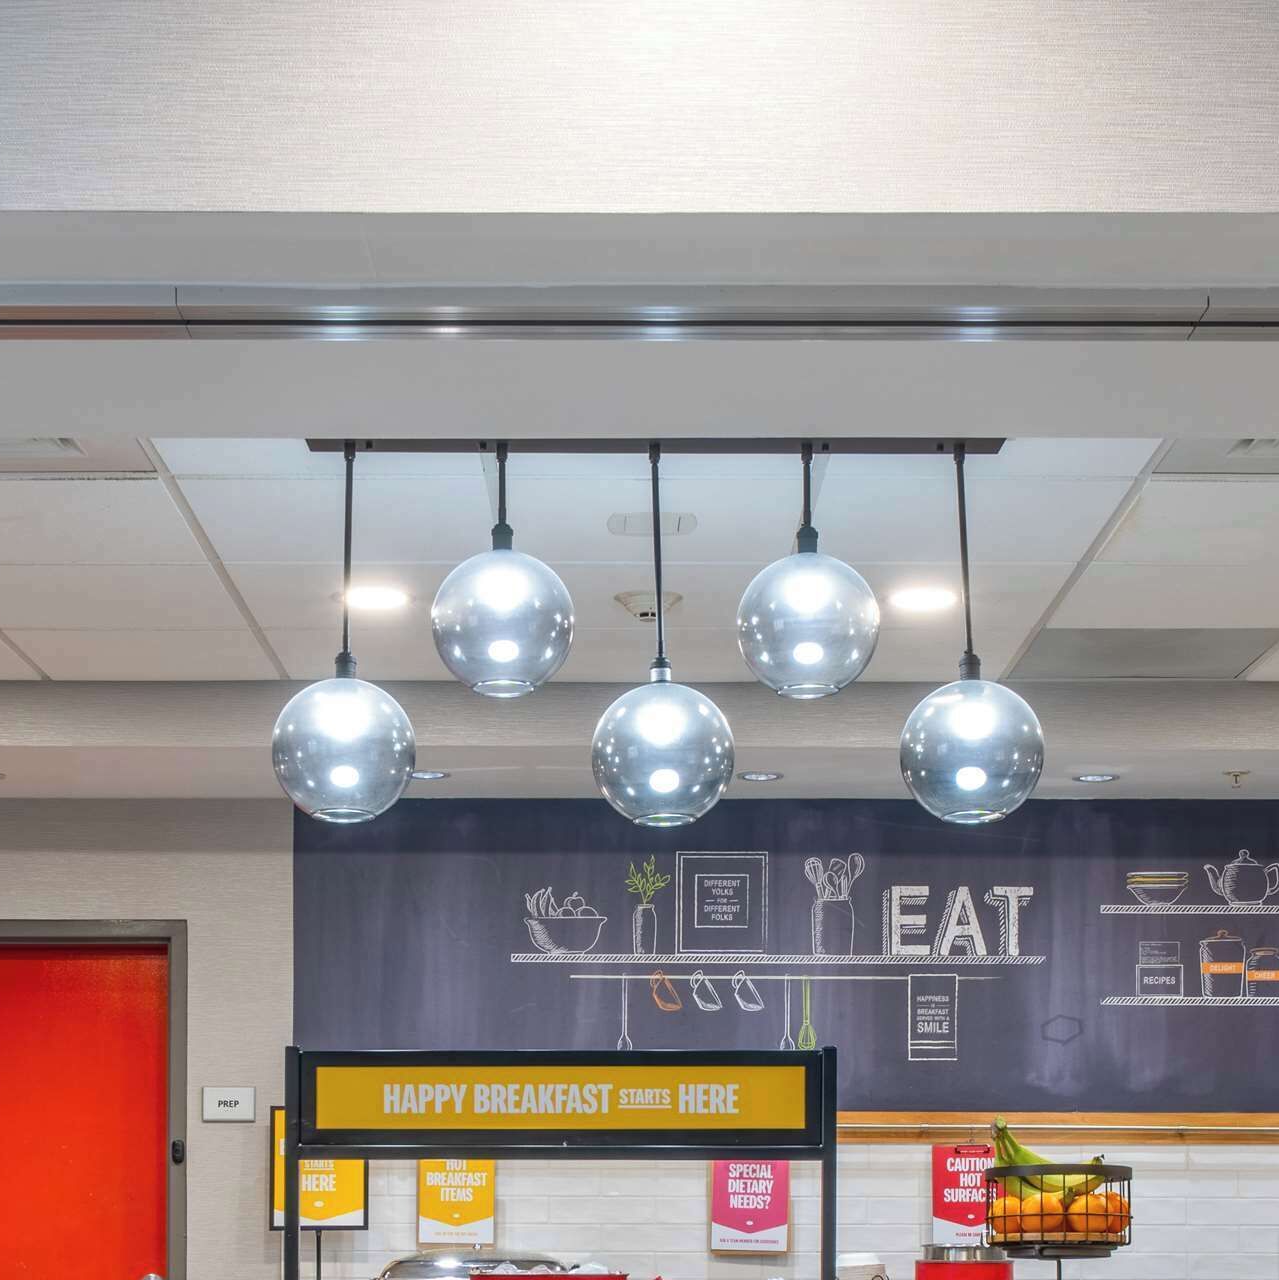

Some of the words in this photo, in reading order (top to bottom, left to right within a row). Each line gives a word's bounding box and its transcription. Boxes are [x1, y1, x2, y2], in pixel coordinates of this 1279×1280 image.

[712, 888, 733, 896] YOLKS
[882, 886, 1034, 956] EAT
[1143, 976, 1176, 985] RECIPES
[917, 1022, 950, 1033] SMILE
[217, 1100, 240, 1108] PREP
[383, 1083, 468, 1114] HAPPY
[473, 1083, 613, 1114] BREAKFAST
[619, 1088, 671, 1104] STARTS
[678, 1083, 740, 1114] HERE
[728, 1163, 774, 1179] SPECIAL
[946, 1157, 995, 1172] CAUTION
[301, 1174, 337, 1192] HERE
[426, 1172, 488, 1187] BREAKFAST
[727, 1179, 774, 1194] DIETARY
[959, 1173, 982, 1187] HOT
[440, 1187, 473, 1202] ITEMS
[729, 1194, 772, 1209] NEEDS?
